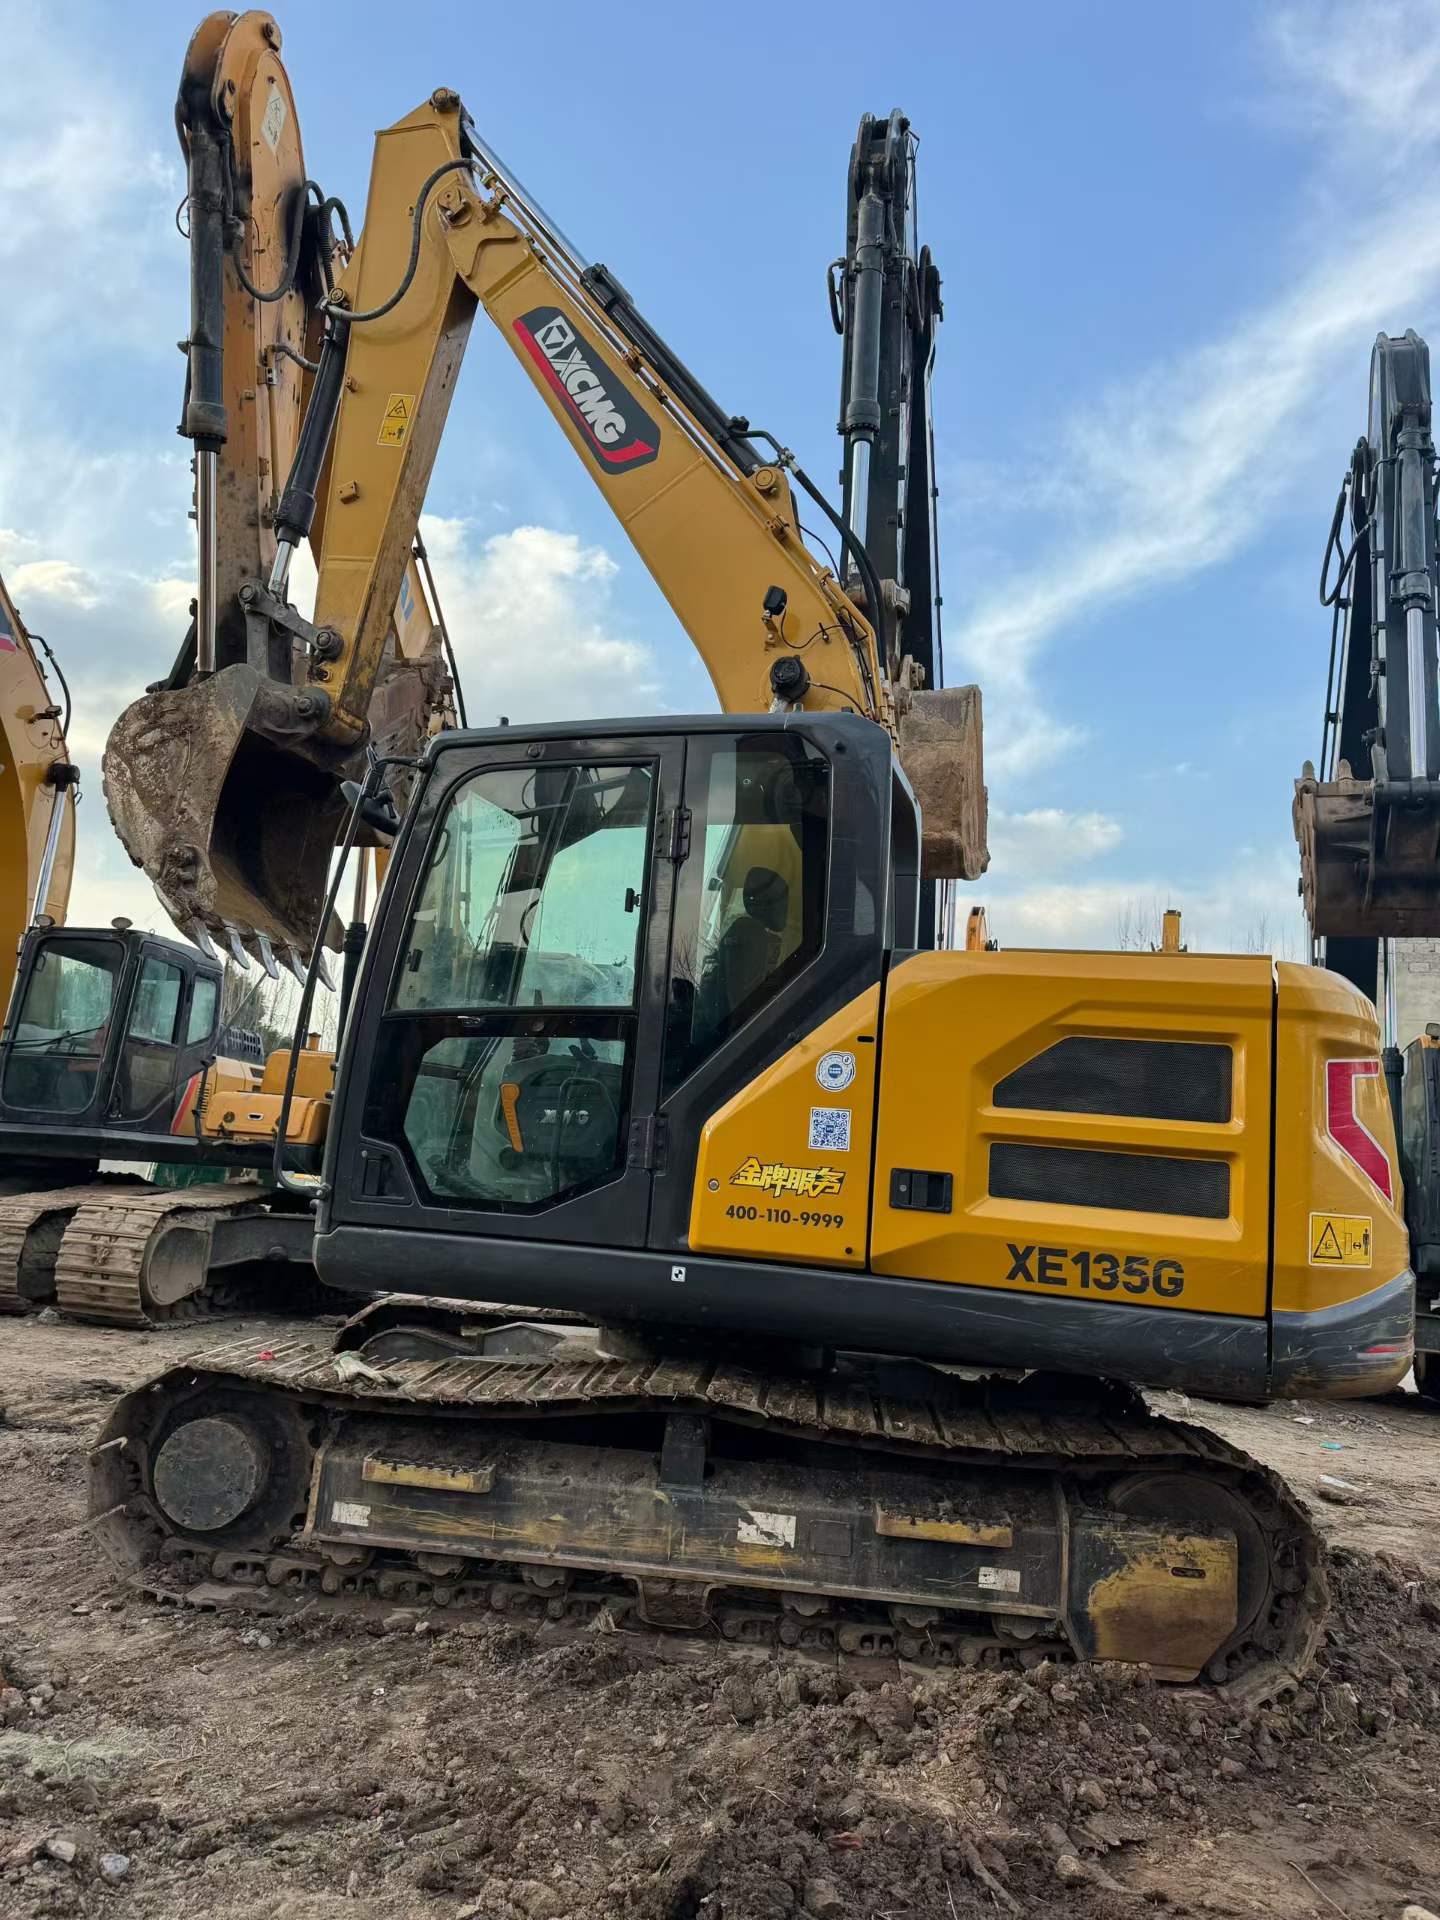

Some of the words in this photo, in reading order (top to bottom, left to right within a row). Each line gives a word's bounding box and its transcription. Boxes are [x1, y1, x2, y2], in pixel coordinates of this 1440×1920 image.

[548, 347, 627, 444] XCMG
[729, 1157, 846, 1198] 金牌服务
[726, 1204, 844, 1229] 400-110-9999
[1005, 1243, 1185, 1298] XE135G
